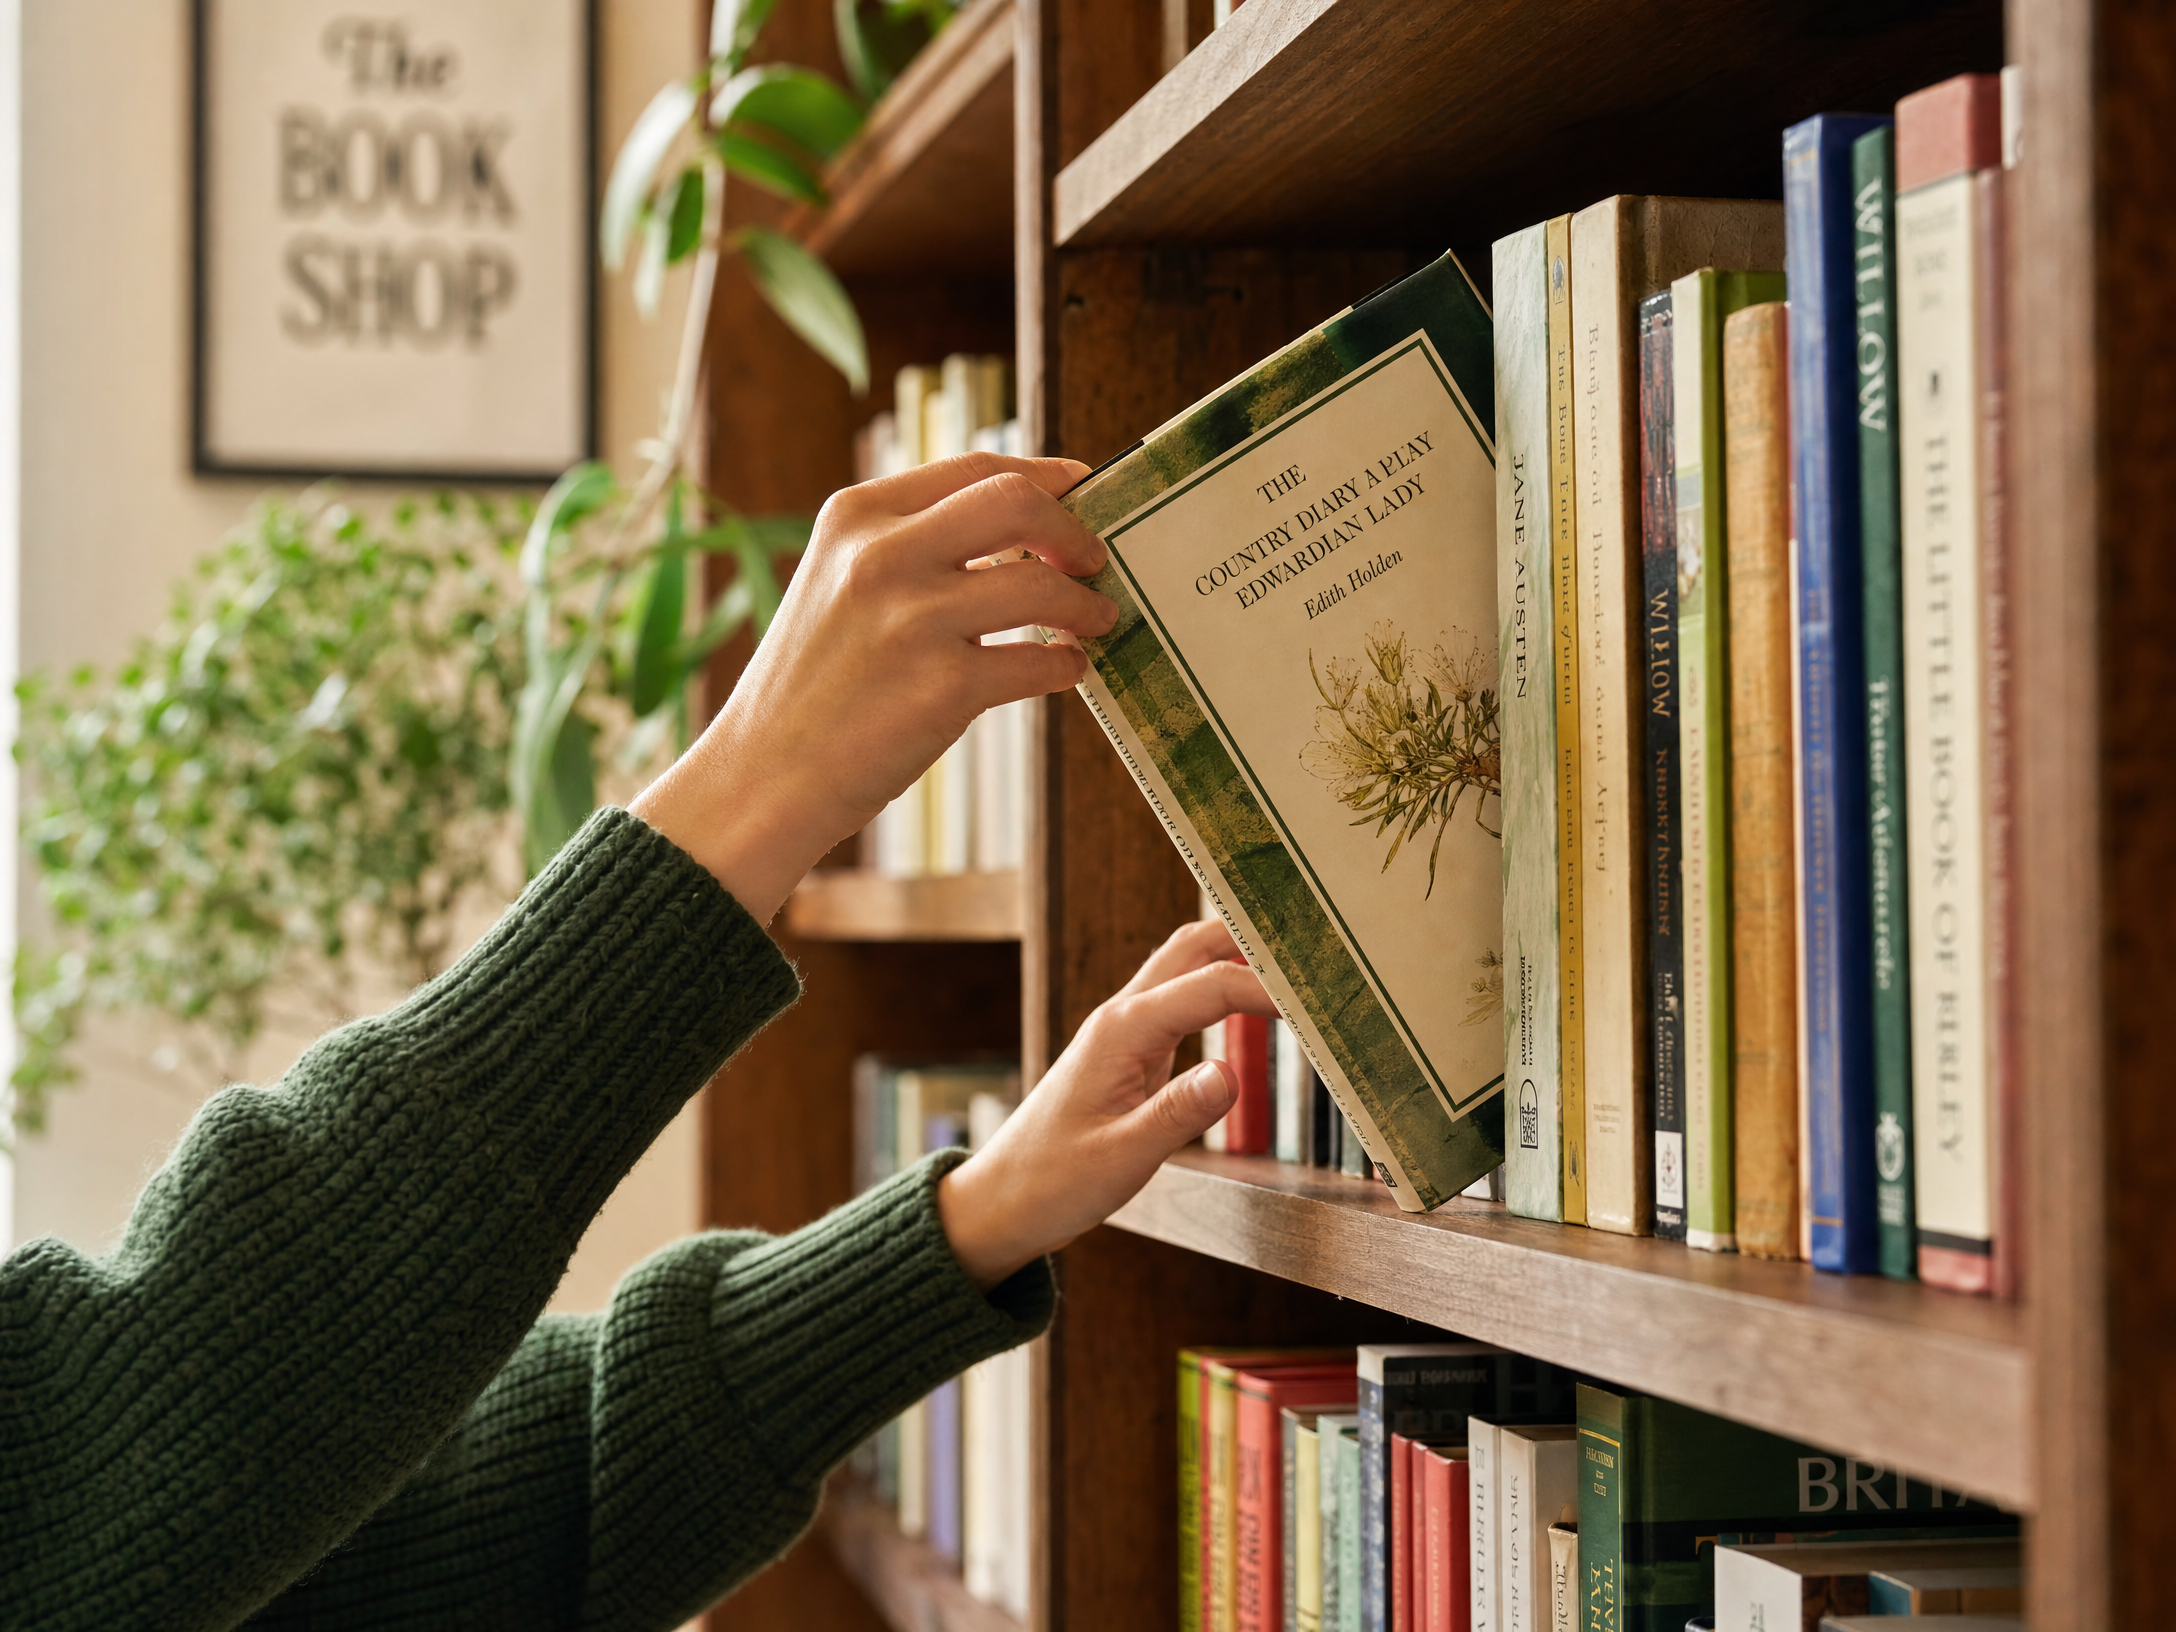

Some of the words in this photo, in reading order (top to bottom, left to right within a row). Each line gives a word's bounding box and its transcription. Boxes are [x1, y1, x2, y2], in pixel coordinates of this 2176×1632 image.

[322, 14, 460, 97] The
[278, 104, 516, 226] BOOK
[279, 233, 517, 352] SHOP
[1195, 521, 1294, 596] COUNTRY
[1294, 477, 1361, 532] DIARY
[1234, 514, 1364, 609] EDWARDIAN
[1364, 473, 1425, 525] LADY
[1257, 464, 1307, 504] THE
[1513, 453, 1525, 546] JANE
[1303, 583, 1347, 620] Edith
[1347, 550, 1403, 592] Holden
[1514, 557, 1526, 700] AUSTEN
[1929, 736, 1959, 890] BOOK
[1931, 901, 1960, 977] OF
